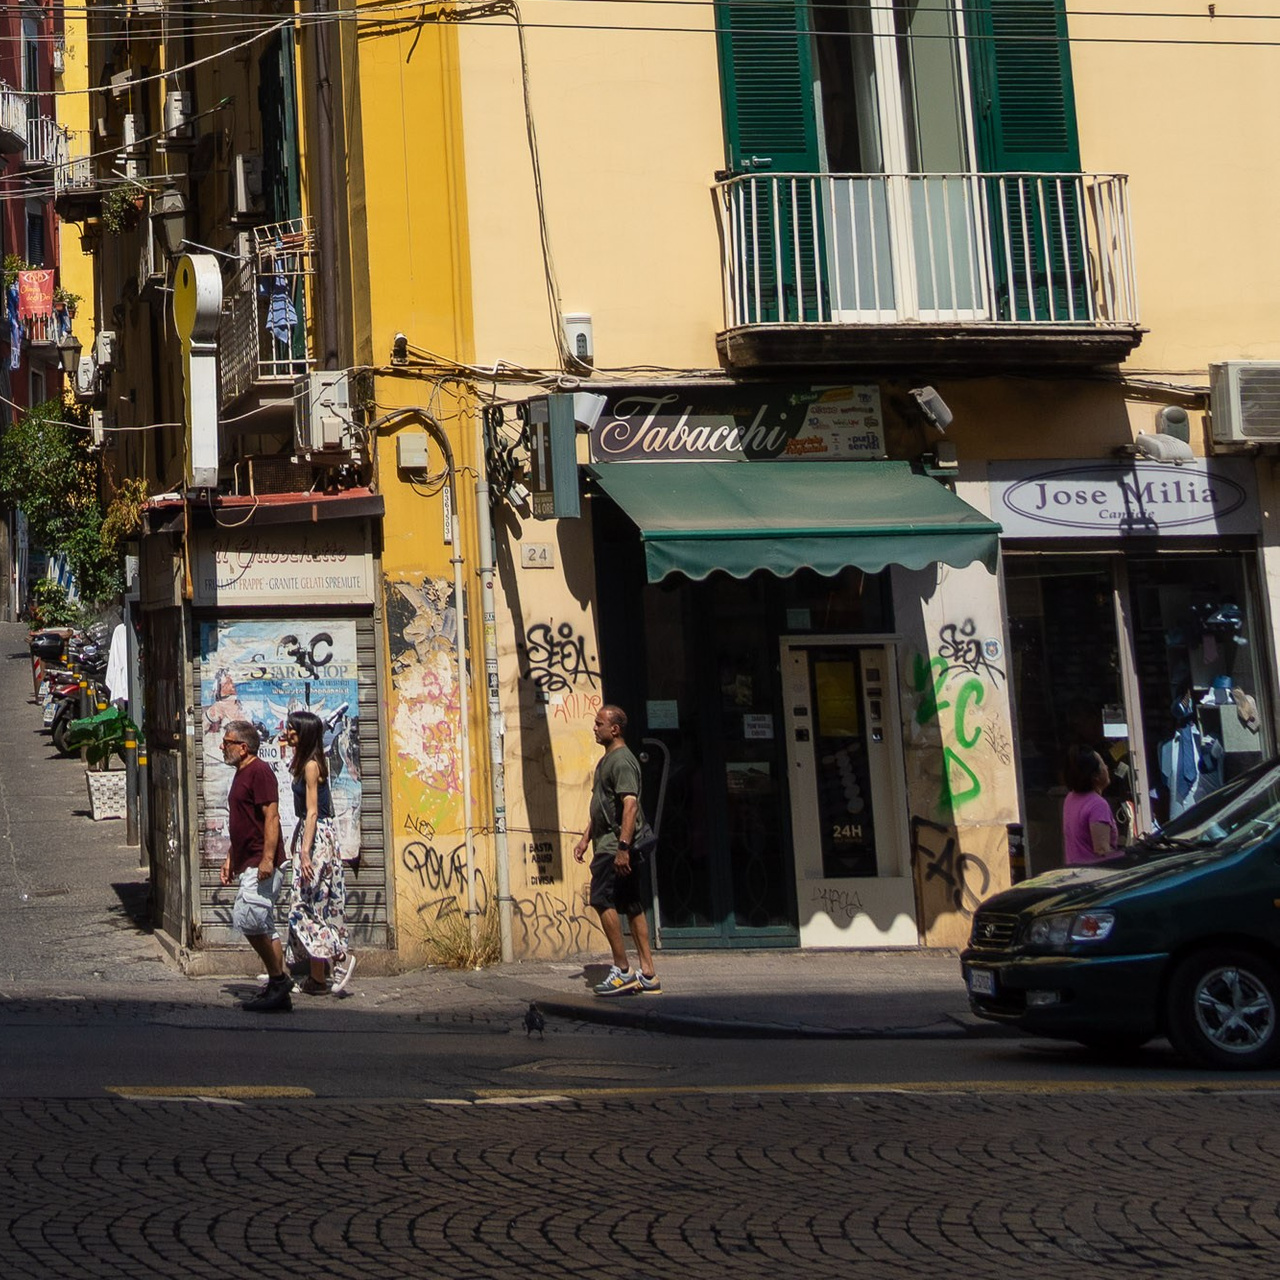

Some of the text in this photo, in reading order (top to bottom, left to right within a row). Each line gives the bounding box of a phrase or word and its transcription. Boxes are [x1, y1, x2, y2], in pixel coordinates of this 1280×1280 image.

[600, 394, 786, 454] Tabacchi
[1034, 480, 1219, 510] Jose Milia
[1098, 508, 1155, 520] Camicie
[527, 547, 548, 561] 24
[270, 577, 299, 590] GRANITE
[301, 577, 325, 589] GELATI
[325, 576, 361, 589] SPREMUTE
[832, 824, 863, 838] 24H
[529, 843, 554, 853] BASTA
[531, 875, 555, 886] DIVISA
